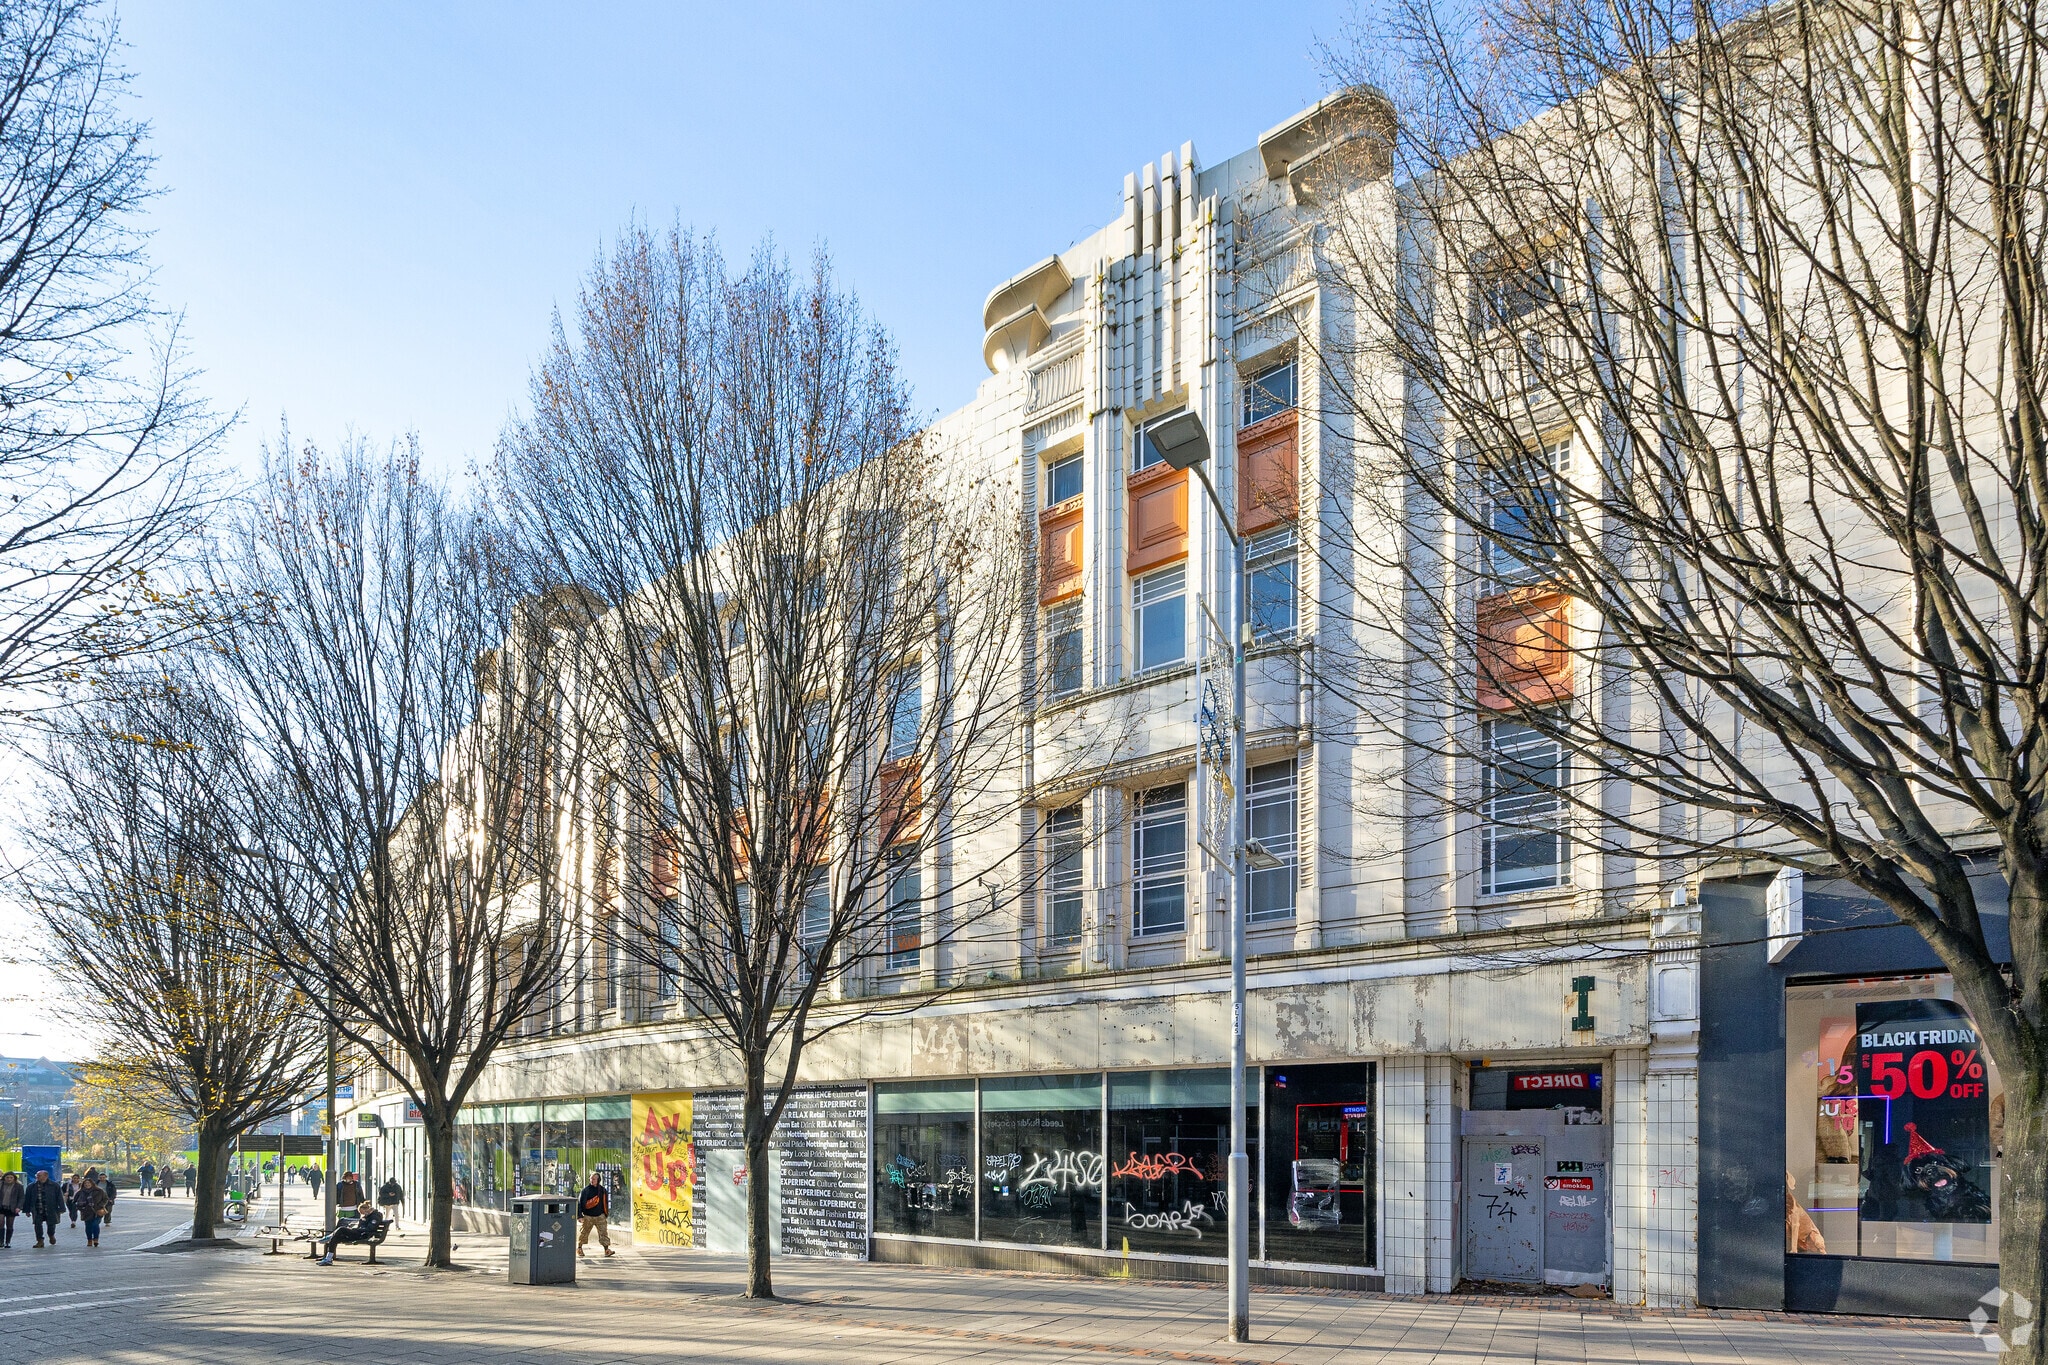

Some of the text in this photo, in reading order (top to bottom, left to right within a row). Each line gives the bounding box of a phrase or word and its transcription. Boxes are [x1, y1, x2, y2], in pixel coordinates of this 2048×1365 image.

[1861, 1030, 1977, 1048] BLACK FRIDAY
[795, 1091, 831, 1099] EXPERIENCE
[1950, 1083, 1984, 1099] OFF
[712, 1104, 739, 1112] Nottingham
[820, 1100, 856, 1108] EXPERIENCE
[788, 1111, 808, 1119] RELAX
[809, 1110, 825, 1118] Retail
[705, 1122, 733, 1130] Community
[642, 1106, 680, 1156] Ay
[787, 1130, 819, 1139] Nottingham
[806, 1140, 838, 1150] Nottingham
[825, 1151, 858, 1160] Nottingham
[781, 1159, 812, 1168] Community
[809, 1169, 842, 1179] Community
[795, 1189, 831, 1197] EXPERIENCE
[820, 1200, 856, 1208] EXPERIENCE
[788, 1207, 808, 1216] RELAX
[816, 1219, 837, 1228] RELAX
[838, 1220, 855, 1229] Retail
[787, 1227, 819, 1236] Nottingham
[806, 1238, 838, 1248] Nottingham
